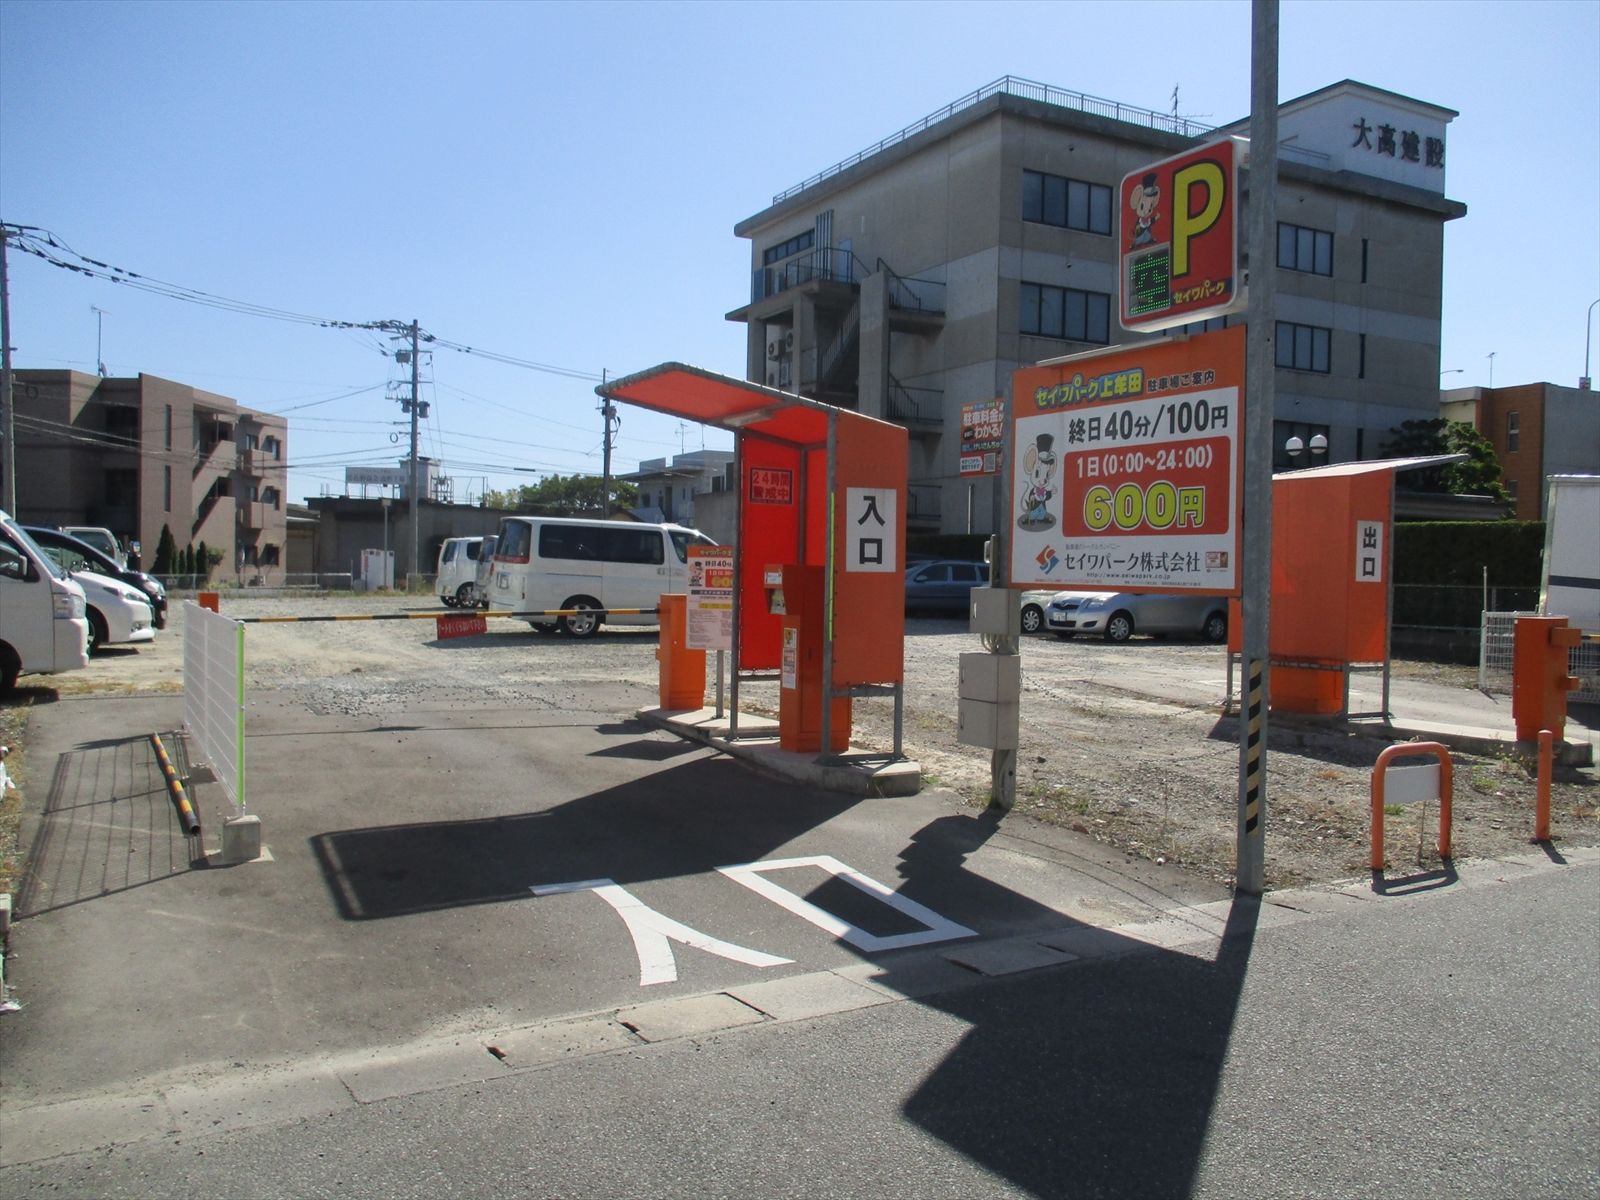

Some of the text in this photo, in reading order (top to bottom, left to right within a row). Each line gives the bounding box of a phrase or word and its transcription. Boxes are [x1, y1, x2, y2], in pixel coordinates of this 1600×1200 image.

[1352, 117, 1445, 169] 大高建設
[1172, 160, 1225, 277] P
[1130, 252, 1170, 315] 空
[1173, 280, 1225, 304] セイワパーク
[1035, 367, 1215, 409] セイワパーク上牟田 駐車場ご案内
[1068, 399, 1229, 444] 終日40分/100円
[858, 495, 885, 565] 入口
[1084, 480, 1206, 531] 600円
[1065, 550, 1201, 573] セイワパーク株式会社
[1363, 526, 1378, 576] 出口
